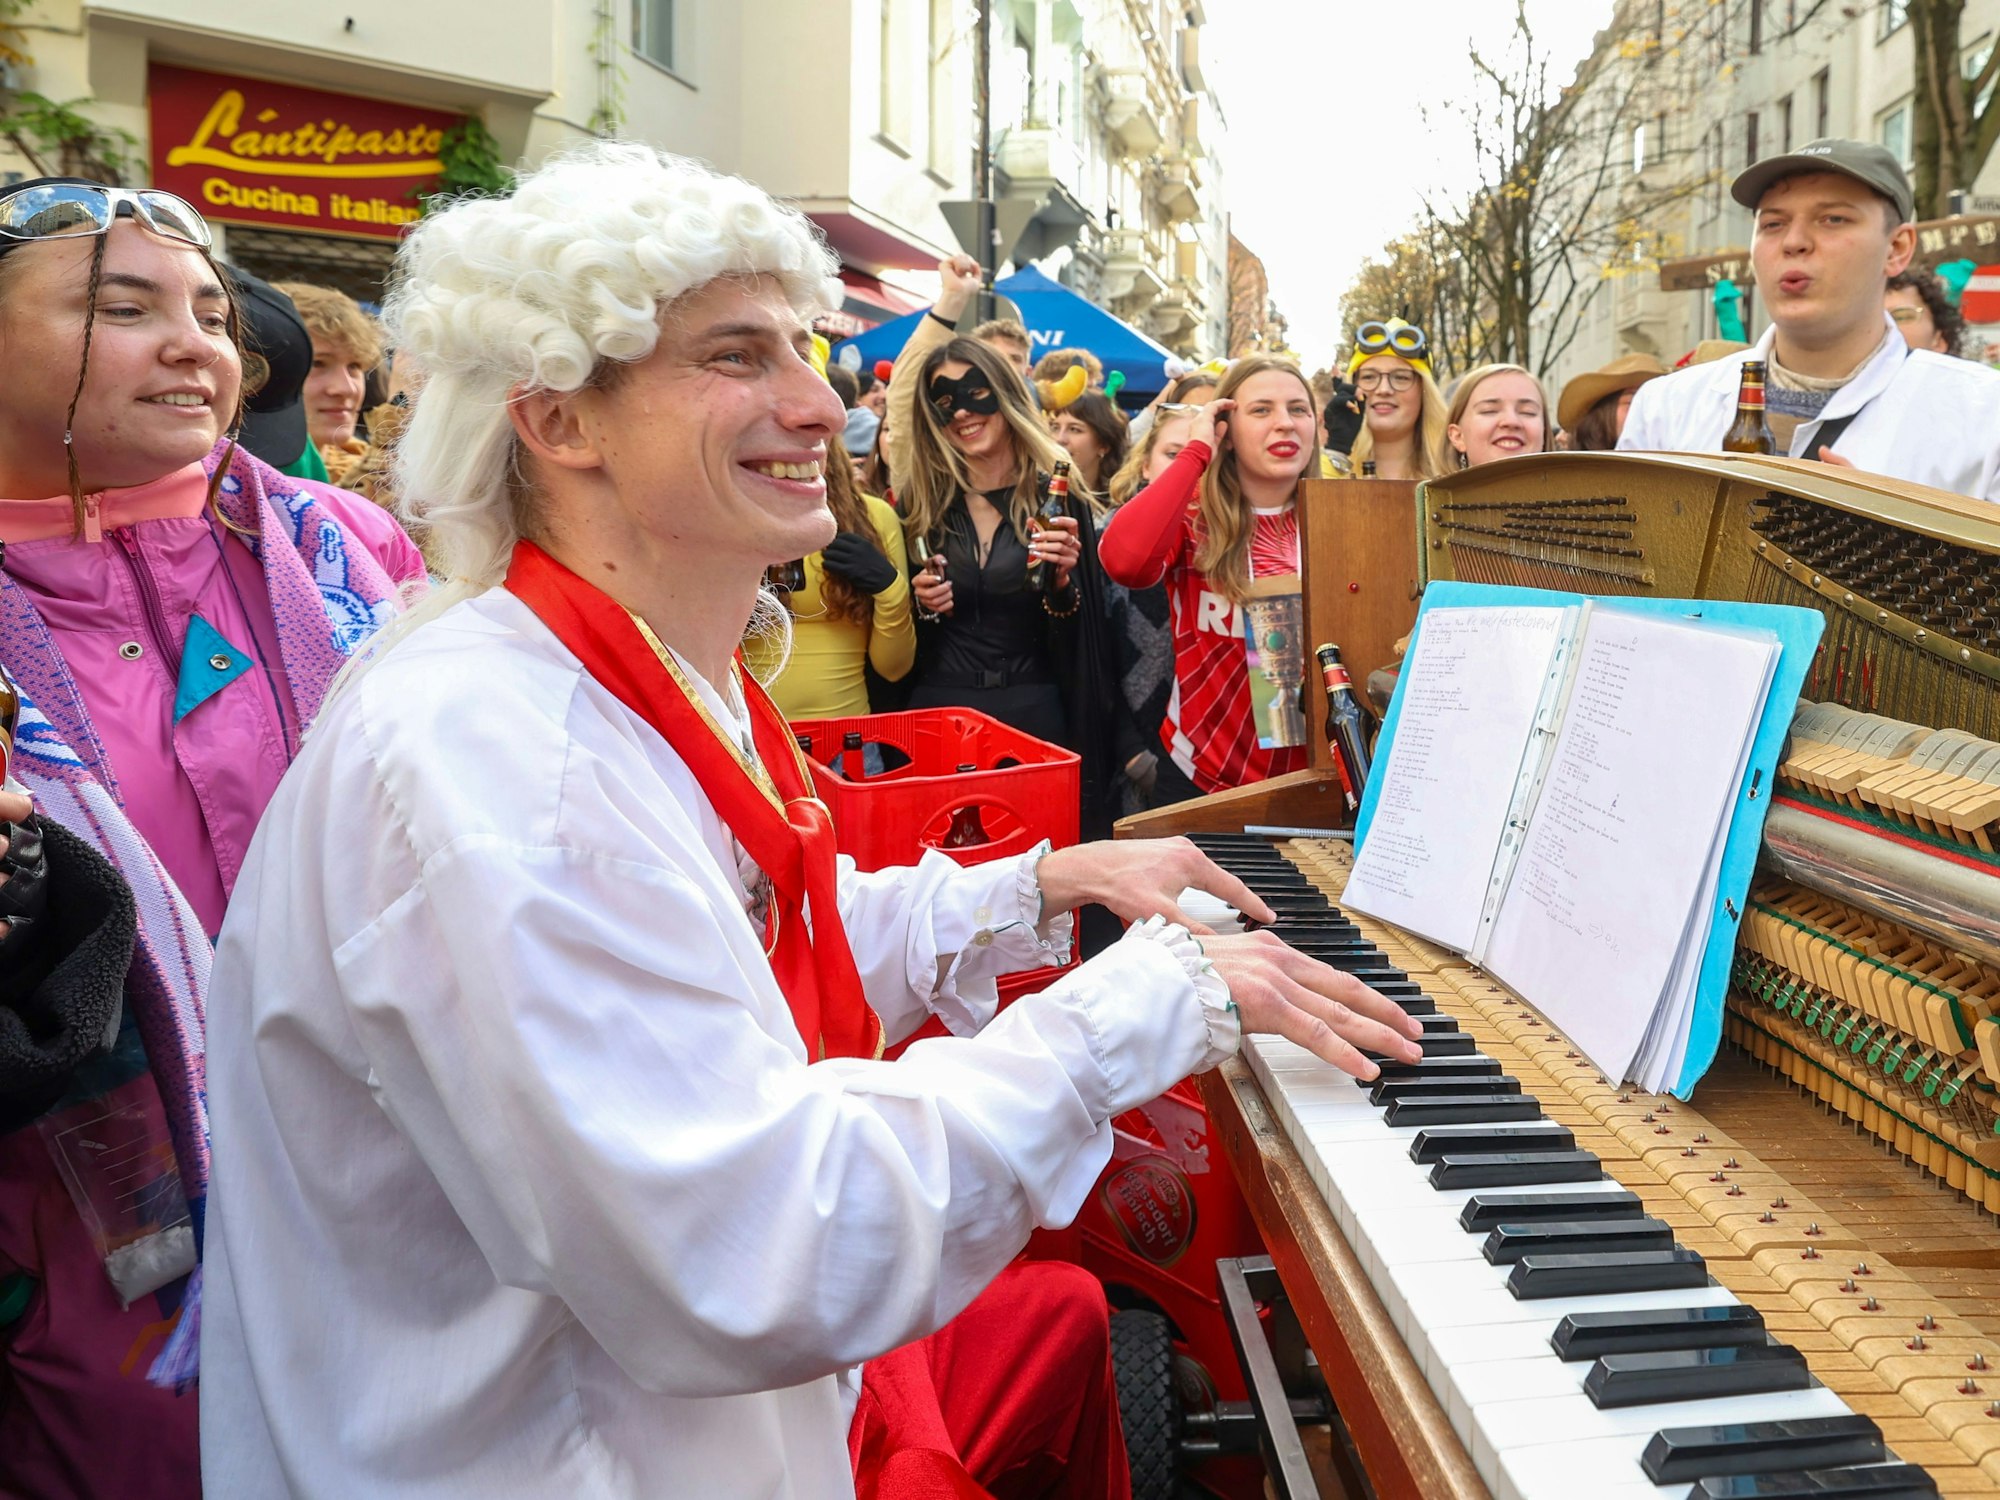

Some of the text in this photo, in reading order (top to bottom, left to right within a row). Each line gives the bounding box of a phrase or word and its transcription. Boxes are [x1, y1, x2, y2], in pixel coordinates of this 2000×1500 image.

[202, 177, 421, 226] Cucina italian
[1124, 1171, 1177, 1246] Reissdorf
